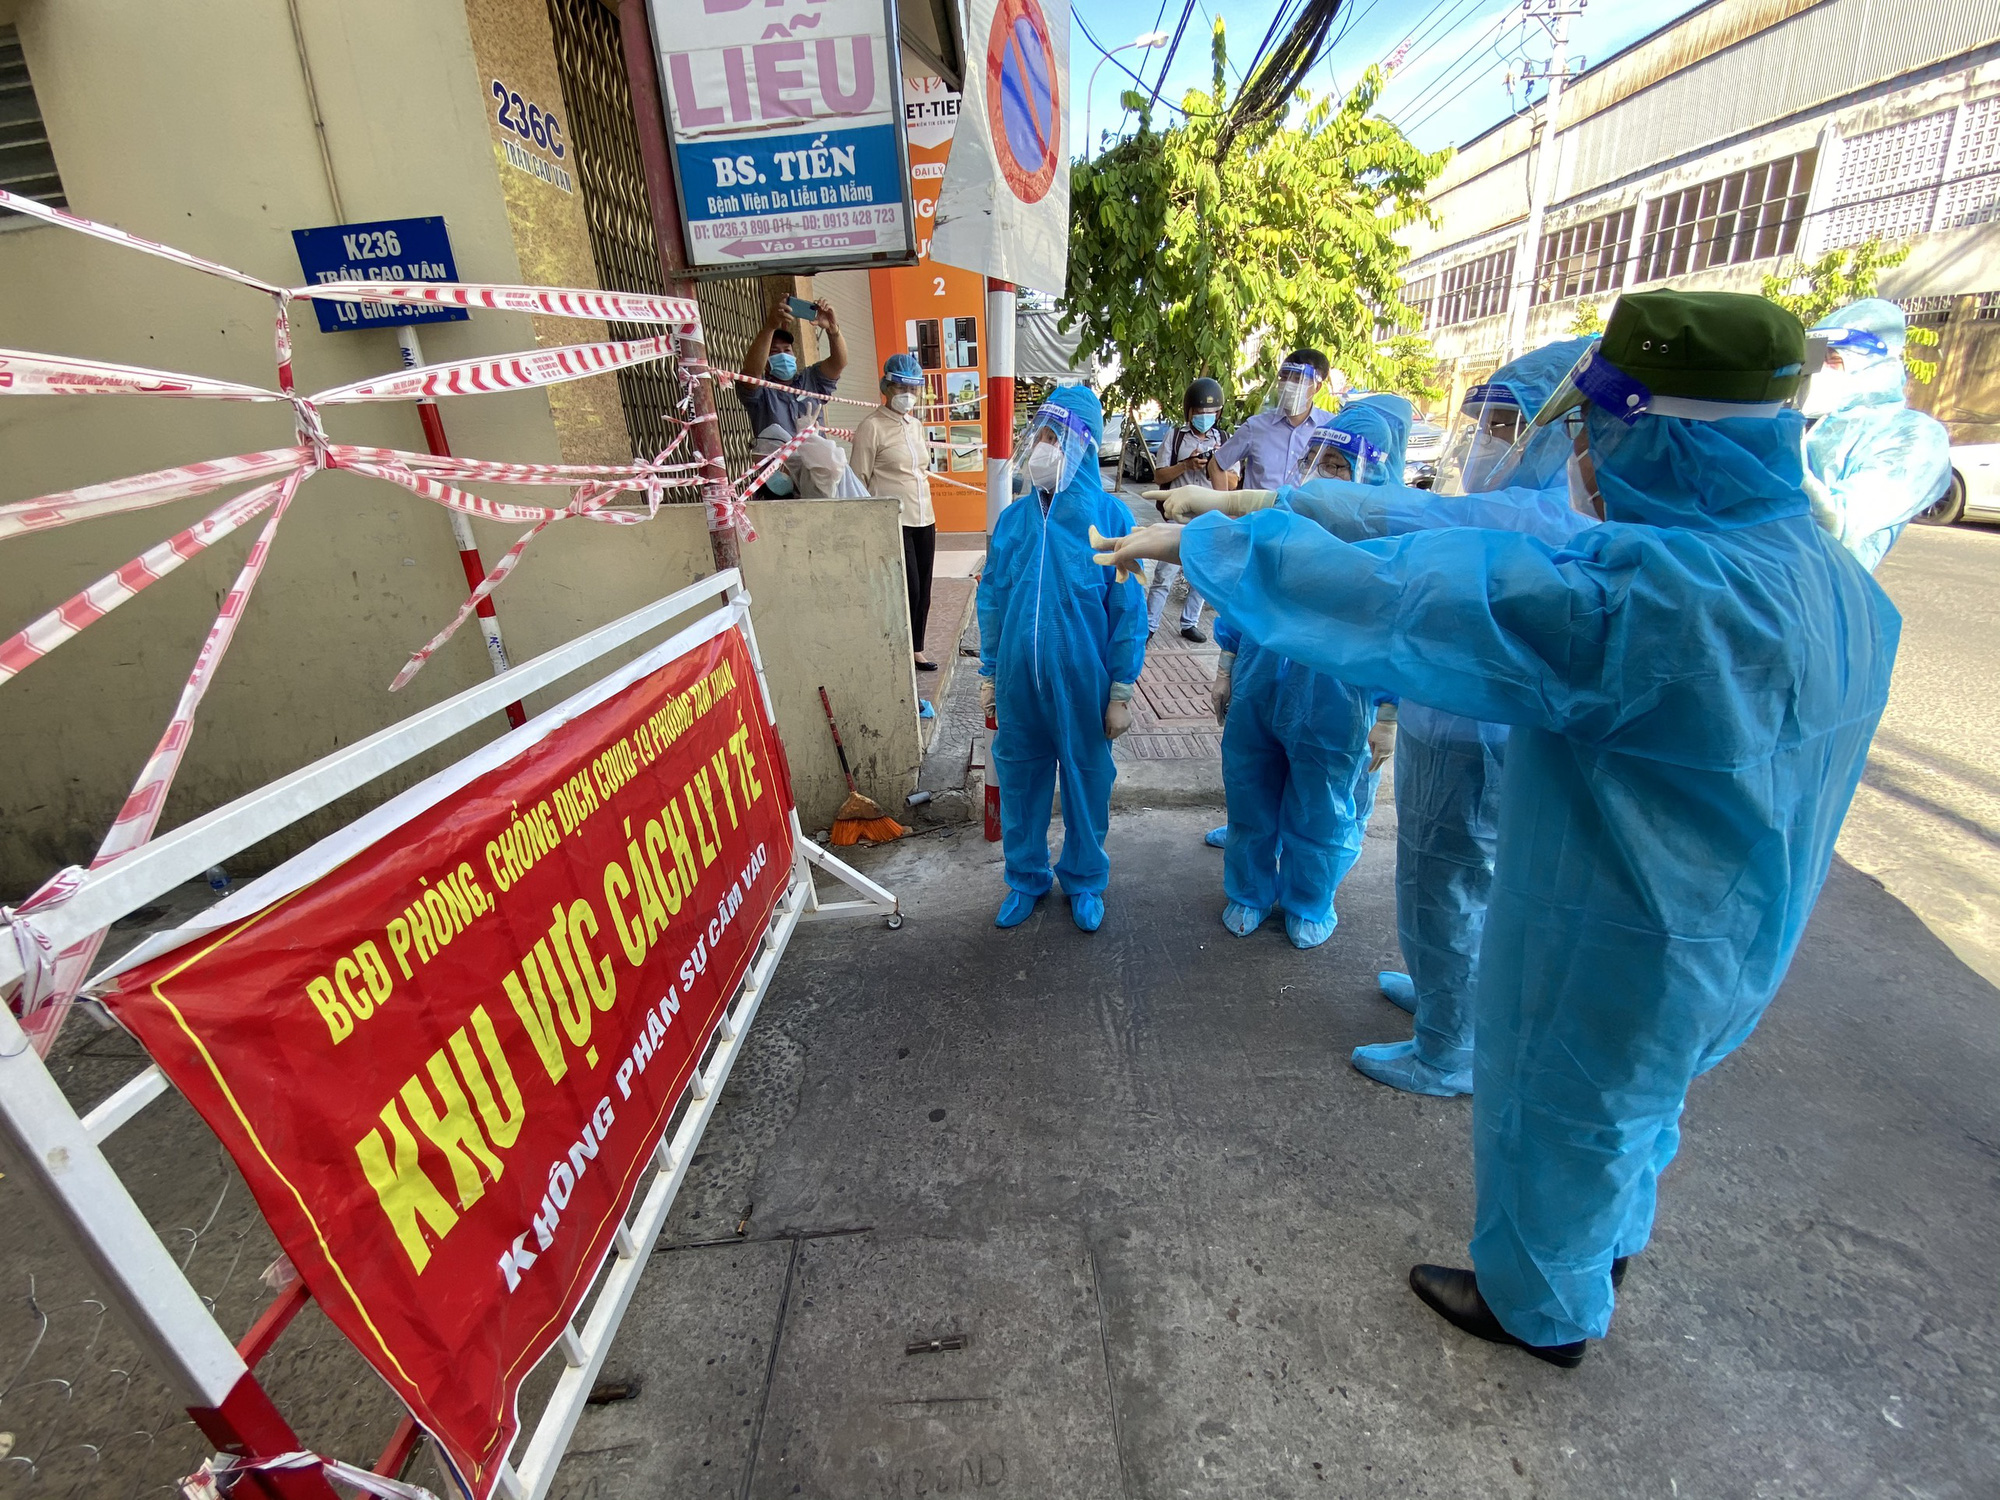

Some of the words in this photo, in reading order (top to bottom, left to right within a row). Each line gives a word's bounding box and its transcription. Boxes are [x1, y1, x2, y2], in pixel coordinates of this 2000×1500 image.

[669, 12, 876, 128] LIỄU
[491, 79, 565, 160] 236C
[530, 154, 553, 184] CAO
[712, 155, 767, 187] BS.
[774, 134, 856, 182] TIẾN
[914, 167, 930, 178] ĐẠI
[707, 194, 740, 217] Bệnh
[741, 191, 769, 214] Viện
[771, 191, 789, 209] Da
[790, 185, 818, 206] Liễu
[820, 186, 837, 204] Đà
[840, 180, 873, 203] Nẵng
[712, 221, 748, 239] 0236.3
[750, 219, 770, 236] 890
[823, 212, 849, 229] 0913
[852, 210, 872, 226] 428
[874, 208, 895, 224] 723
[343, 230, 402, 261] K236
[761, 241, 795, 252] Vào
[801, 236, 850, 249] 150m
[368, 265, 405, 282] CAO
[407, 261, 447, 279] VÂN
[933, 277, 946, 296] 2
[1322, 430, 1348, 442] Shield
[305, 940, 393, 1046] BCĐ
[386, 862, 496, 981] PHÒNG,
[485, 800, 561, 892] CHỐNG
[552, 768, 600, 837] DỊCH
[592, 724, 656, 801] COVID-19
[648, 692, 694, 754] PHƯỜNG
[688, 676, 713, 719] TAM
[354, 1004, 526, 1276] KHU
[501, 898, 617, 1086] VỰC
[603, 797, 699, 967] CÁCH
[683, 765, 723, 869] LY
[711, 747, 739, 831] Y
[728, 696, 763, 811] TẾ
[497, 1096, 616, 1294] KHÔNG
[615, 985, 680, 1097] PHẬN
[678, 933, 709, 993] SỰ
[708, 881, 744, 950] CẤM
[740, 842, 767, 890] VÀO
